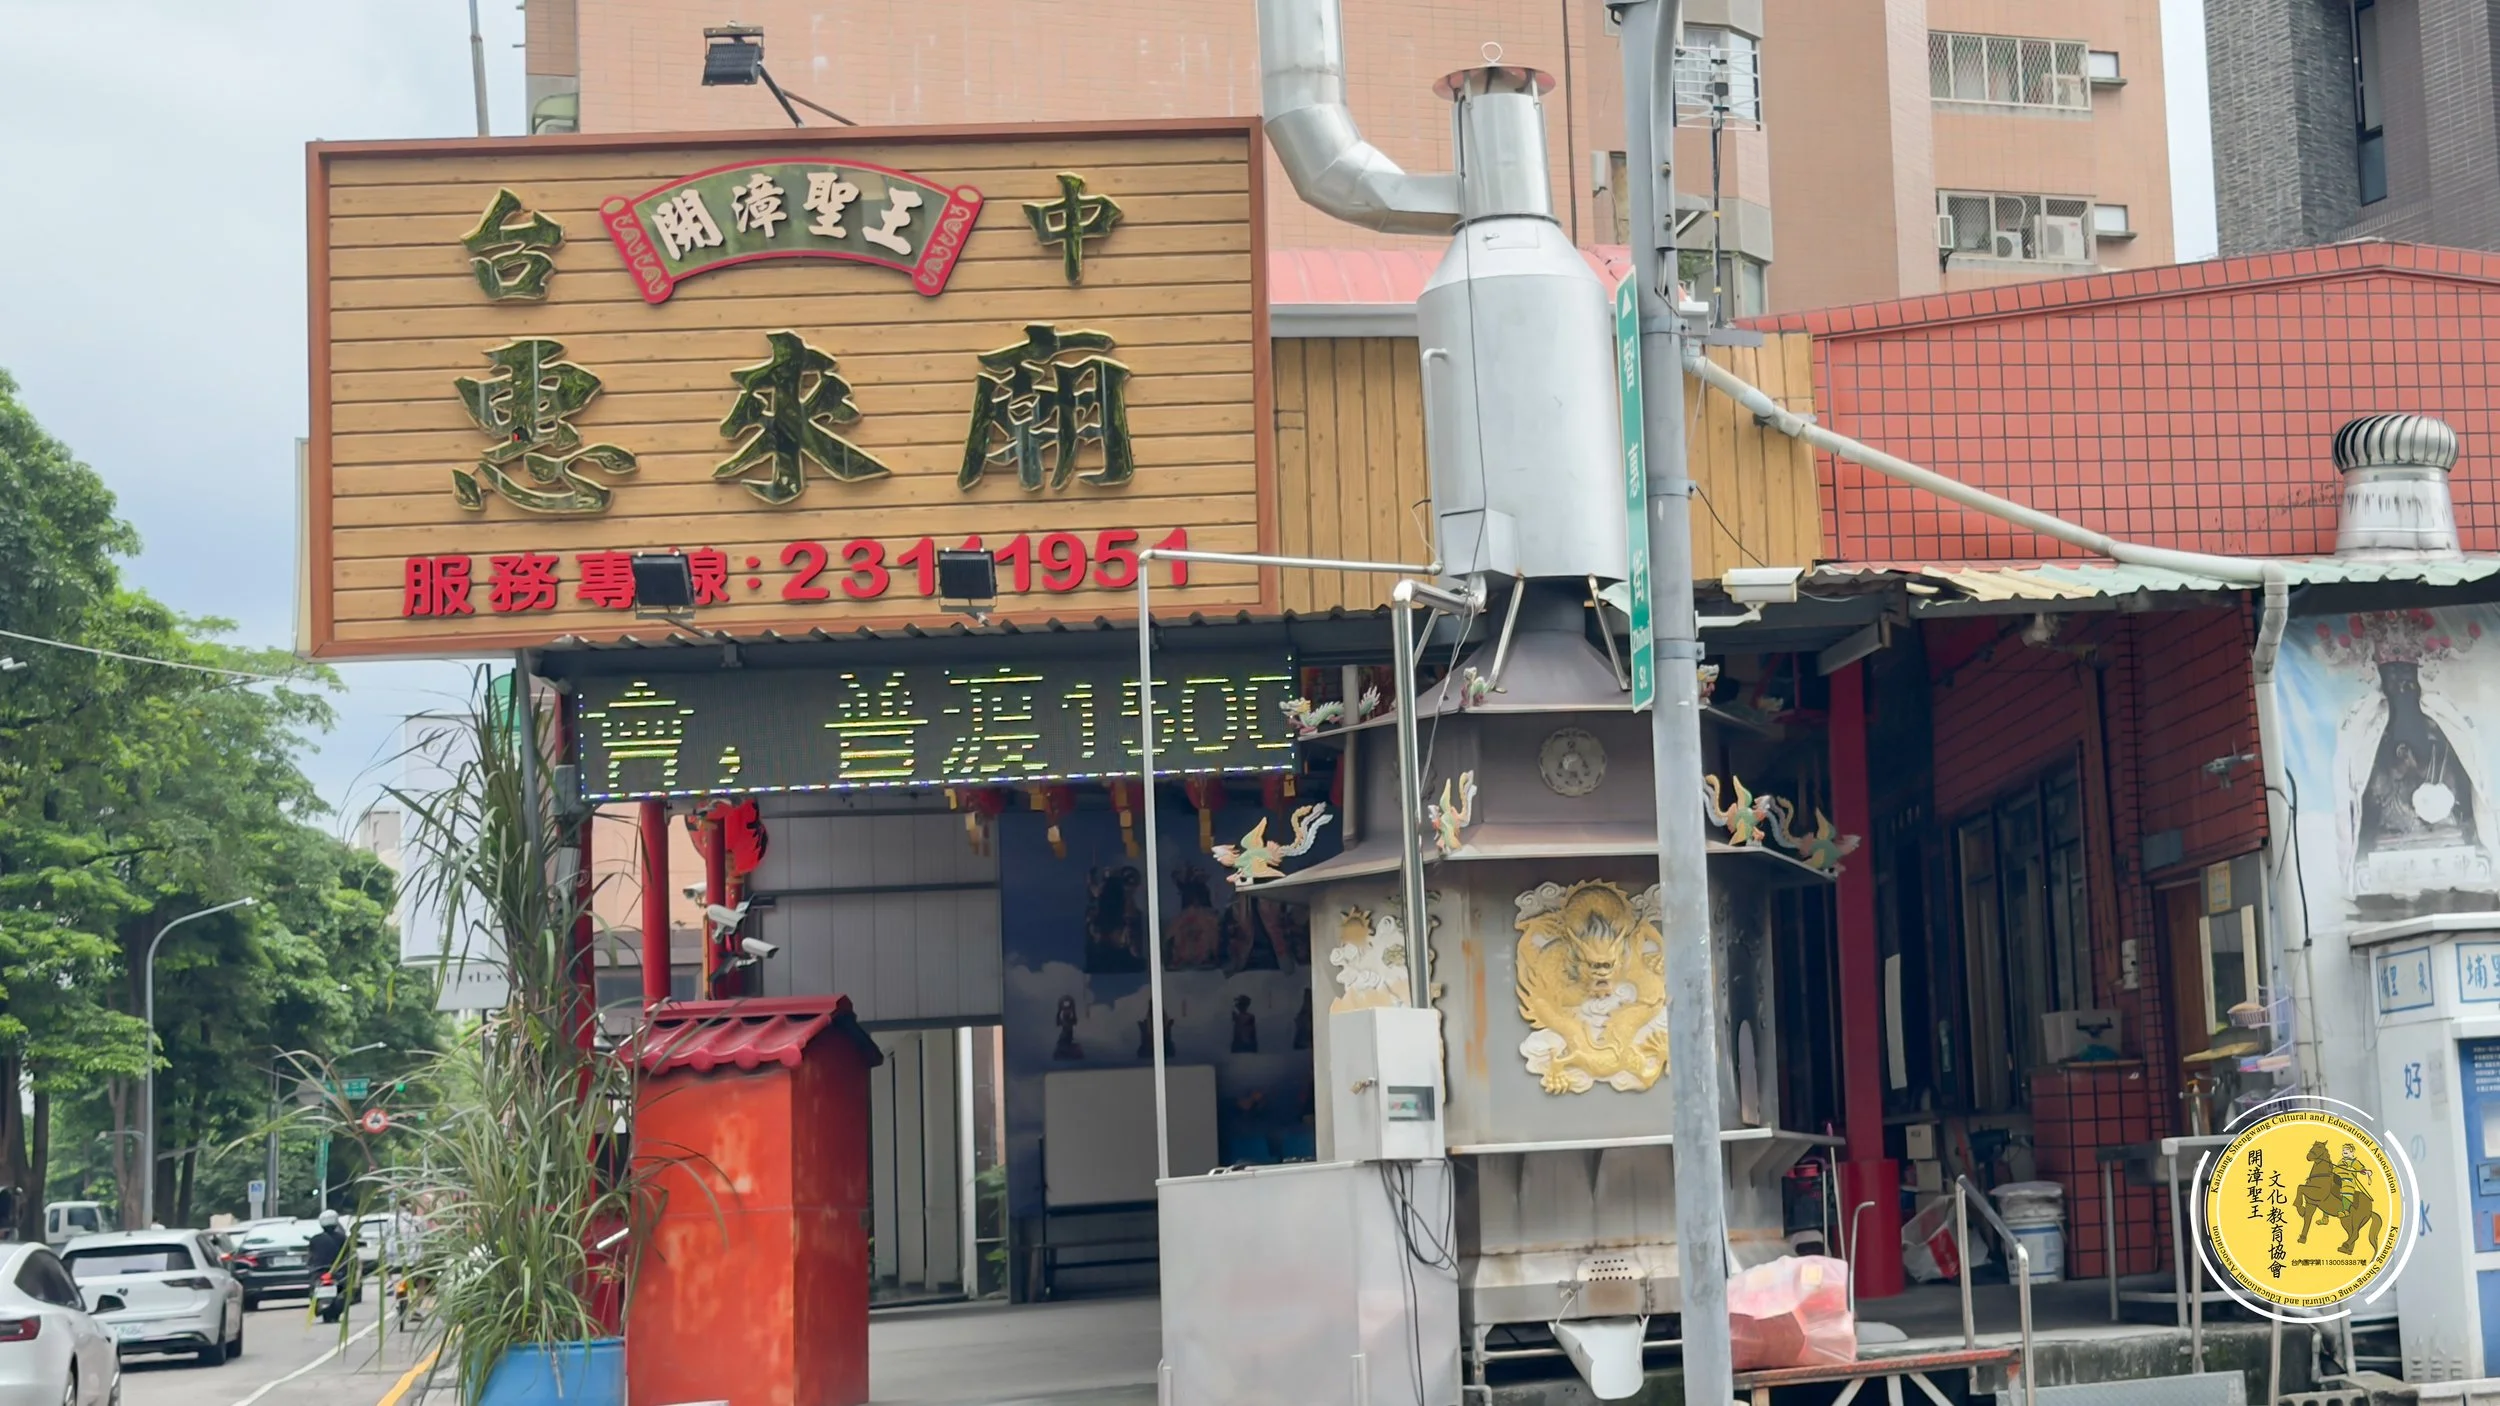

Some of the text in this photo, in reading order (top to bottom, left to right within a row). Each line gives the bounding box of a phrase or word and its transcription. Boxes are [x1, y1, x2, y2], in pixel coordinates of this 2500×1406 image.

[460, 172, 1125, 302] 台 中
[652, 171, 923, 261] 開漳聖王
[451, 323, 1137, 515] 惠來廟
